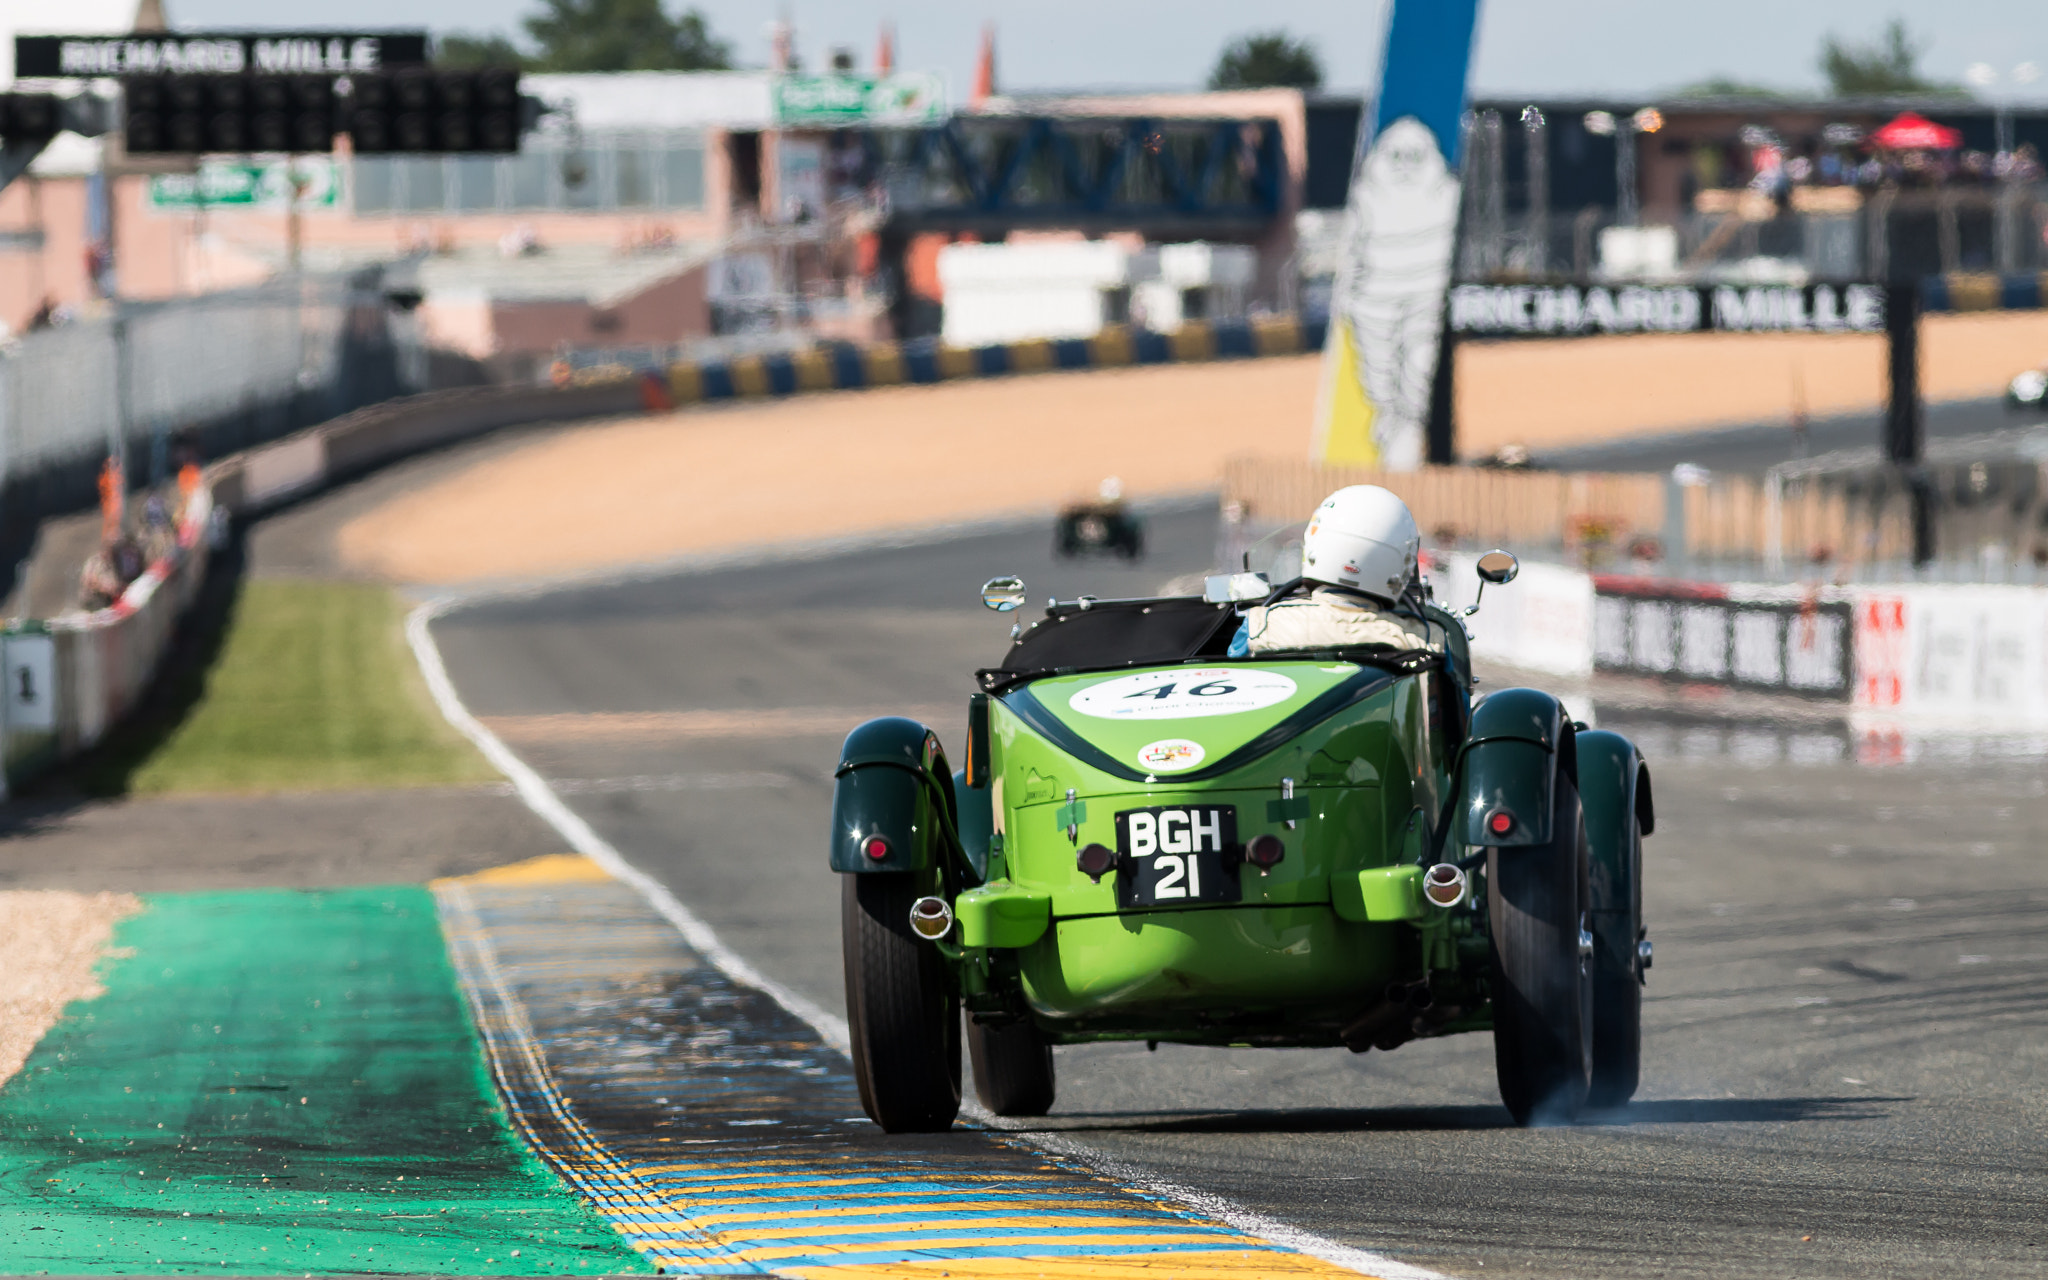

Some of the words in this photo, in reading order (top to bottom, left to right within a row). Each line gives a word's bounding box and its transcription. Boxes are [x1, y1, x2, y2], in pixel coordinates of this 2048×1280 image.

[60, 39, 246, 73] RICHARD
[252, 38, 383, 73] MILLE
[1450, 284, 1700, 332] RICHARD
[1712, 284, 1887, 332] MILLE
[1122, 679, 1238, 700] 46
[1128, 809, 1222, 858] BGH
[1153, 854, 1200, 900] 21
